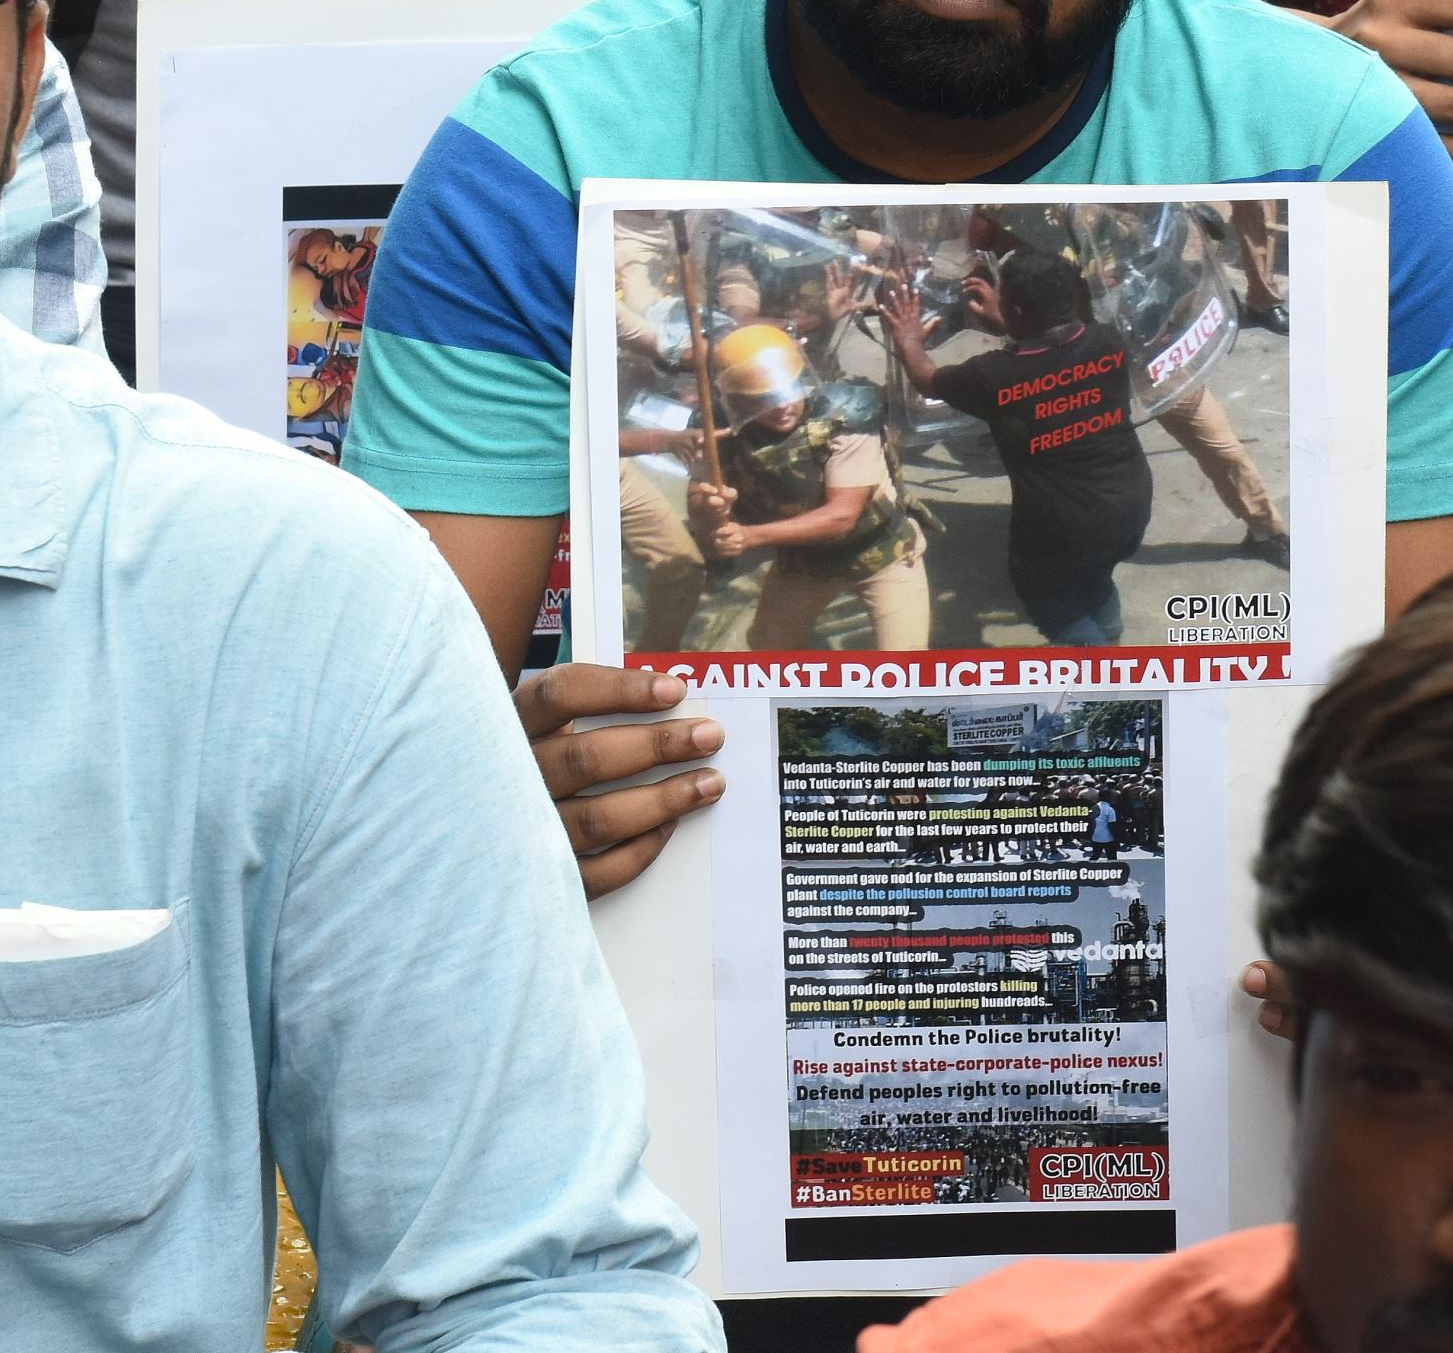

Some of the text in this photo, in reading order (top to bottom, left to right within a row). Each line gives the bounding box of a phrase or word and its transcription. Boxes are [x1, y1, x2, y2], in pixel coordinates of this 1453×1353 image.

[1150, 305, 1223, 383] POLICE
[999, 351, 1125, 406] DEMOCRACY
[1035, 388, 1101, 420] RIGHTS
[1030, 408, 1122, 455] FREEDOM
[1166, 593, 1291, 625] CPI(ML)
[1168, 624, 1287, 644] LIBERATION
[783, 761, 879, 774] Vedanta-Sterlite
[882, 761, 924, 774] Copper
[928, 760, 949, 772] has
[951, 759, 981, 772] been
[984, 758, 1035, 771] dumping
[1039, 757, 1053, 769] its
[1056, 757, 1085, 769] toxic
[784, 778, 807, 790] into
[874, 777, 891, 789] air
[893, 777, 915, 788] and
[918, 777, 950, 788] water
[953, 776, 974, 788] for
[977, 777, 1005, 788] years
[785, 805, 1092, 822] People of Tuticorin were protesting against Vedanta-
[785, 821, 1088, 838] Sterlite Copper for the last few years to protect their
[786, 842, 803, 854] air,
[806, 842, 839, 853] water
[842, 842, 864, 853] and
[787, 868, 1122, 886] Government gave nod for the expansion of Sterlite Copper
[787, 885, 1071, 901] plant despite the pollusion control board reports
[788, 906, 831, 918] against
[834, 905, 853, 916] the
[788, 937, 818, 949] More
[821, 936, 847, 948] than
[1052, 932, 1074, 944] this
[789, 955, 804, 965] on
[806, 952, 825, 964] the
[828, 952, 869, 964] streets
[872, 952, 884, 963] of
[1054, 940, 1163, 961] vedanta
[790, 980, 1037, 996] Police opened fire on the protesters killing
[790, 1001, 821, 1012] more
[823, 999, 849, 1011] than
[852, 999, 863, 1010] 17
[866, 999, 905, 1011] people
[908, 998, 930, 1009] and
[932, 997, 979, 1010] injuring
[834, 1027, 1121, 1047] Condemn the Police brutality!
[793, 1052, 1162, 1077] Rise against state-corporate-police nexus!
[796, 1079, 1161, 1103] Defend peoples right to pollution-free
[860, 1106, 1098, 1127] air, water and livelihood!
[797, 1156, 961, 1175] #SaveTuticorin
[1040, 1152, 1166, 1183] CPI(ML)
[796, 1183, 931, 1202] #BanSterlite
[1043, 1183, 1159, 1200] LIBERATION
